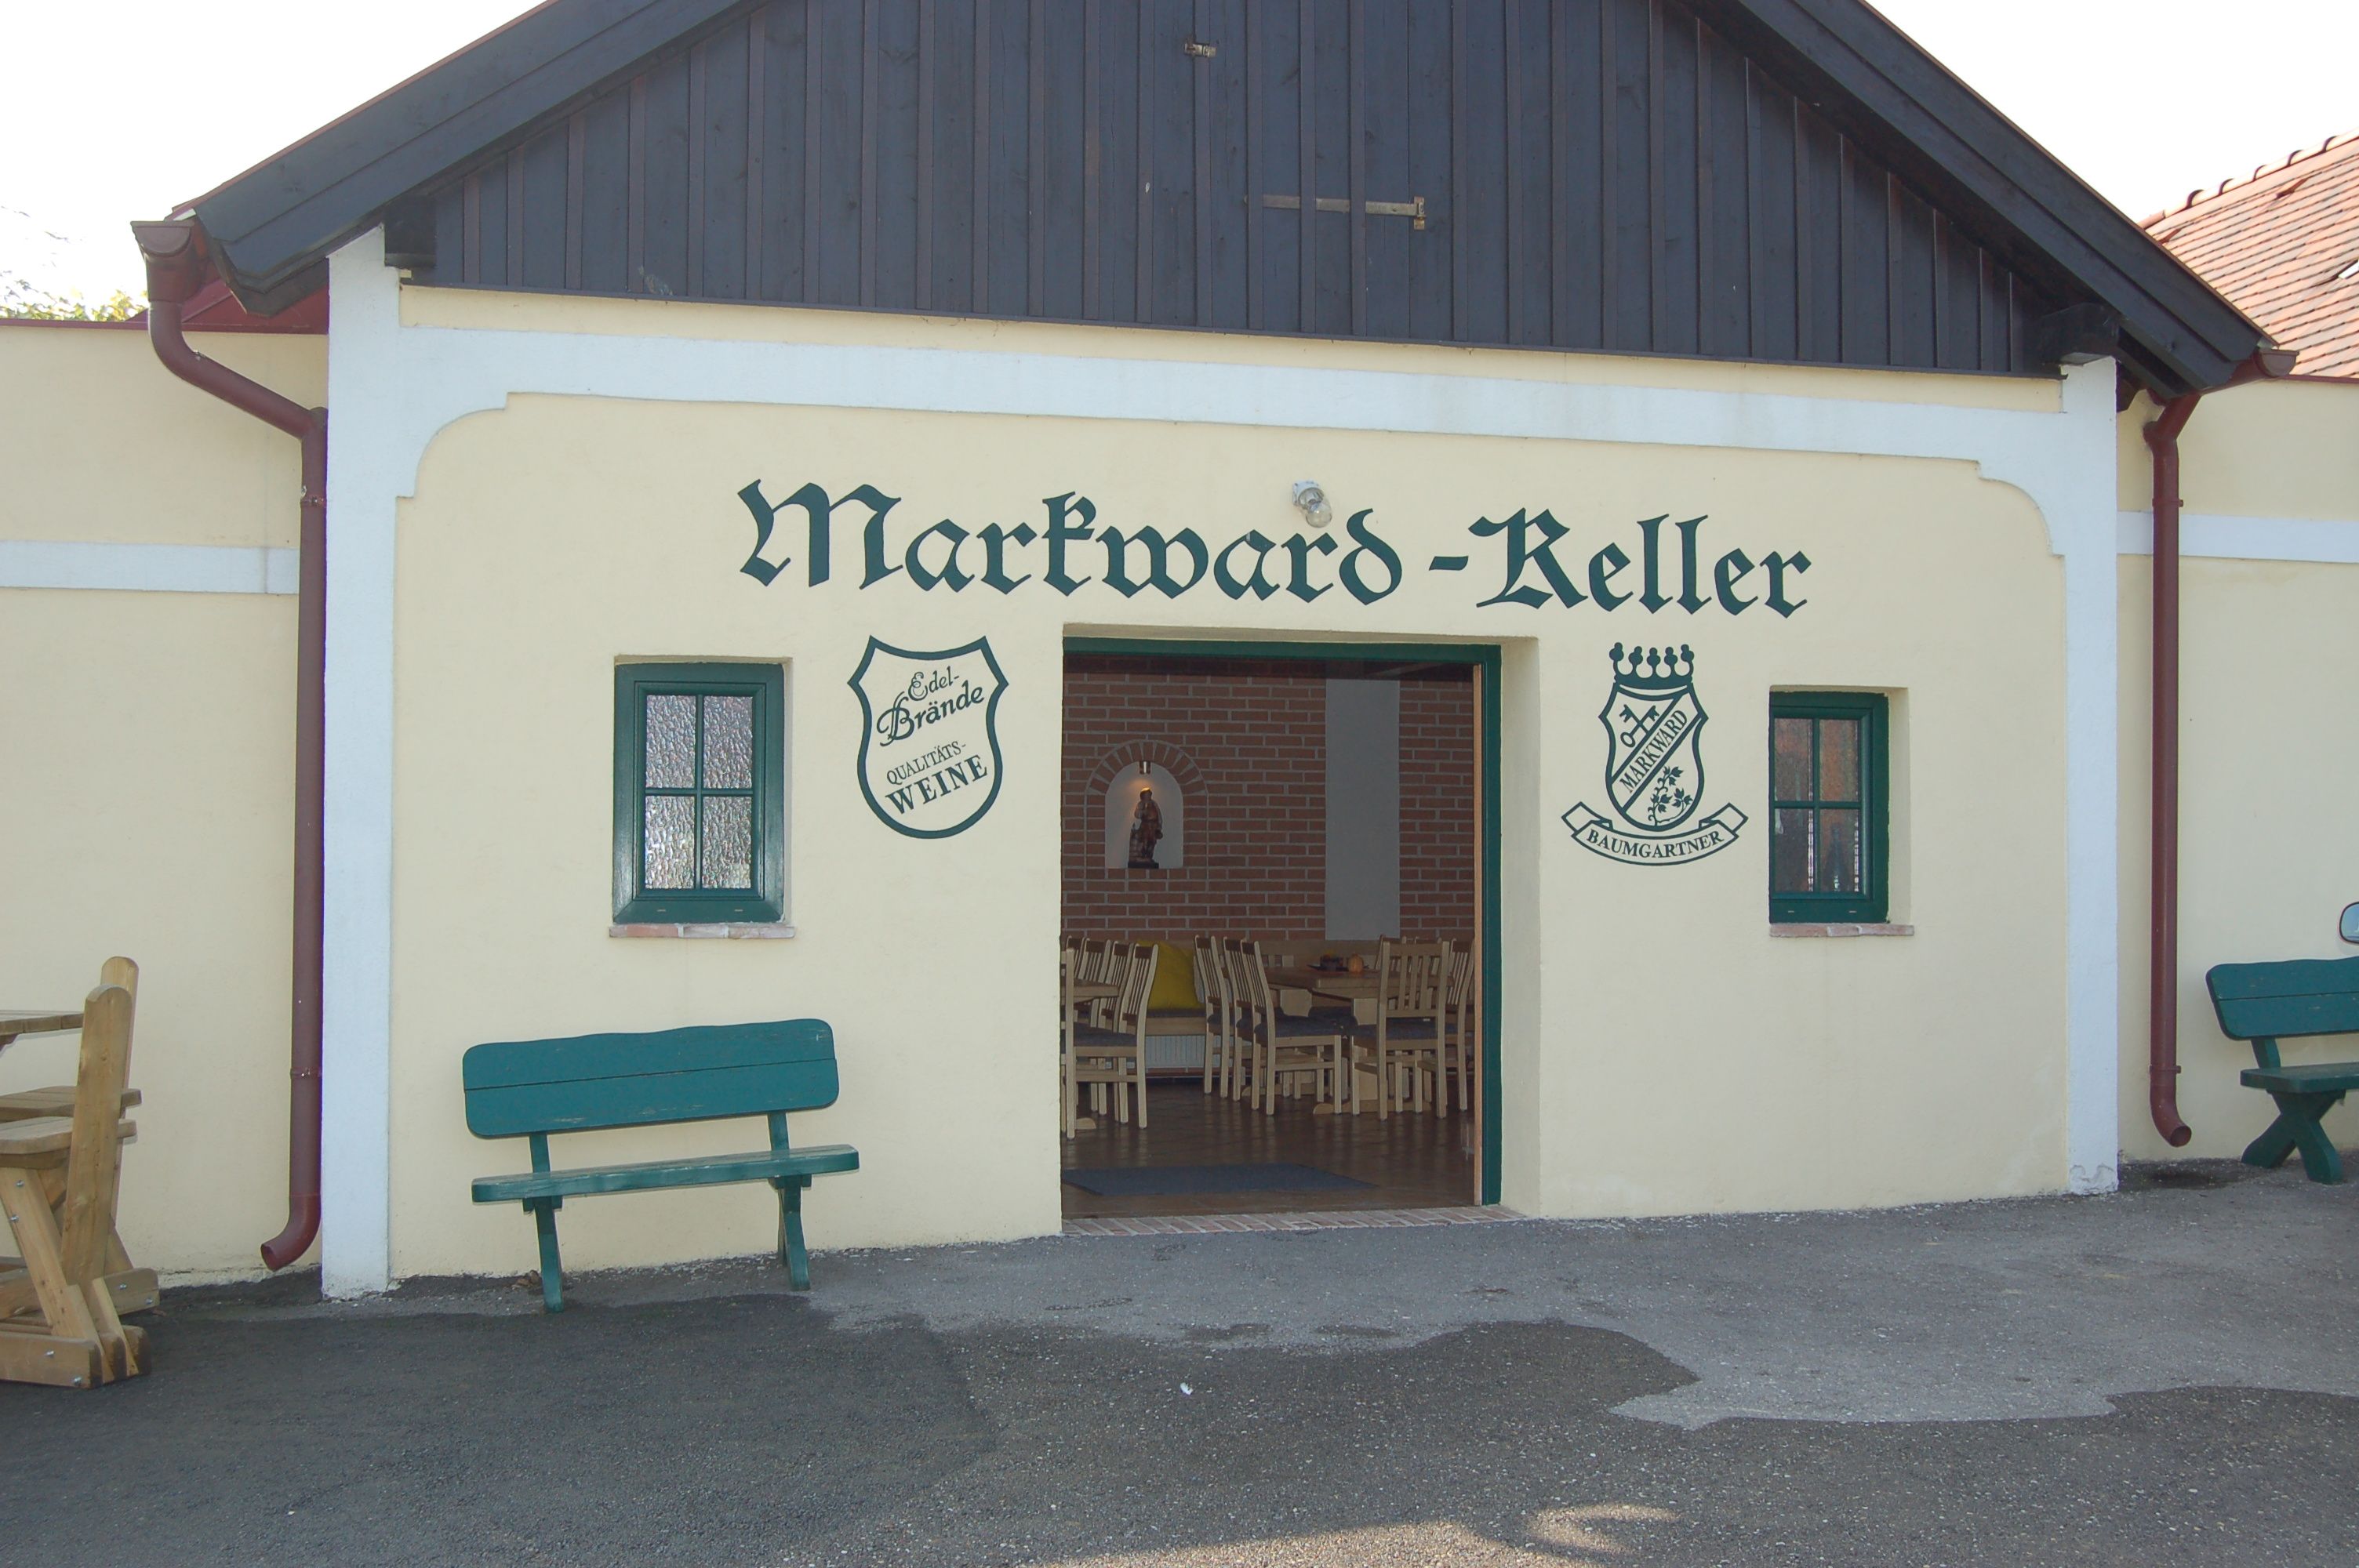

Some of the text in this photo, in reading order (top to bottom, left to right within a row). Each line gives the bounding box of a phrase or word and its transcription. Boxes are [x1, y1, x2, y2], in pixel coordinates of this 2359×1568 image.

[737, 478, 1403, 605] Markward
[876, 679, 985, 747] Brände
[907, 665, 960, 702] Edel-
[886, 740, 967, 786] QUALITÄTS-
[1619, 709, 1688, 794] MARKWARD
[885, 753, 988, 815] WEINE
[1586, 828, 1725, 859] BAUMGARTNER
